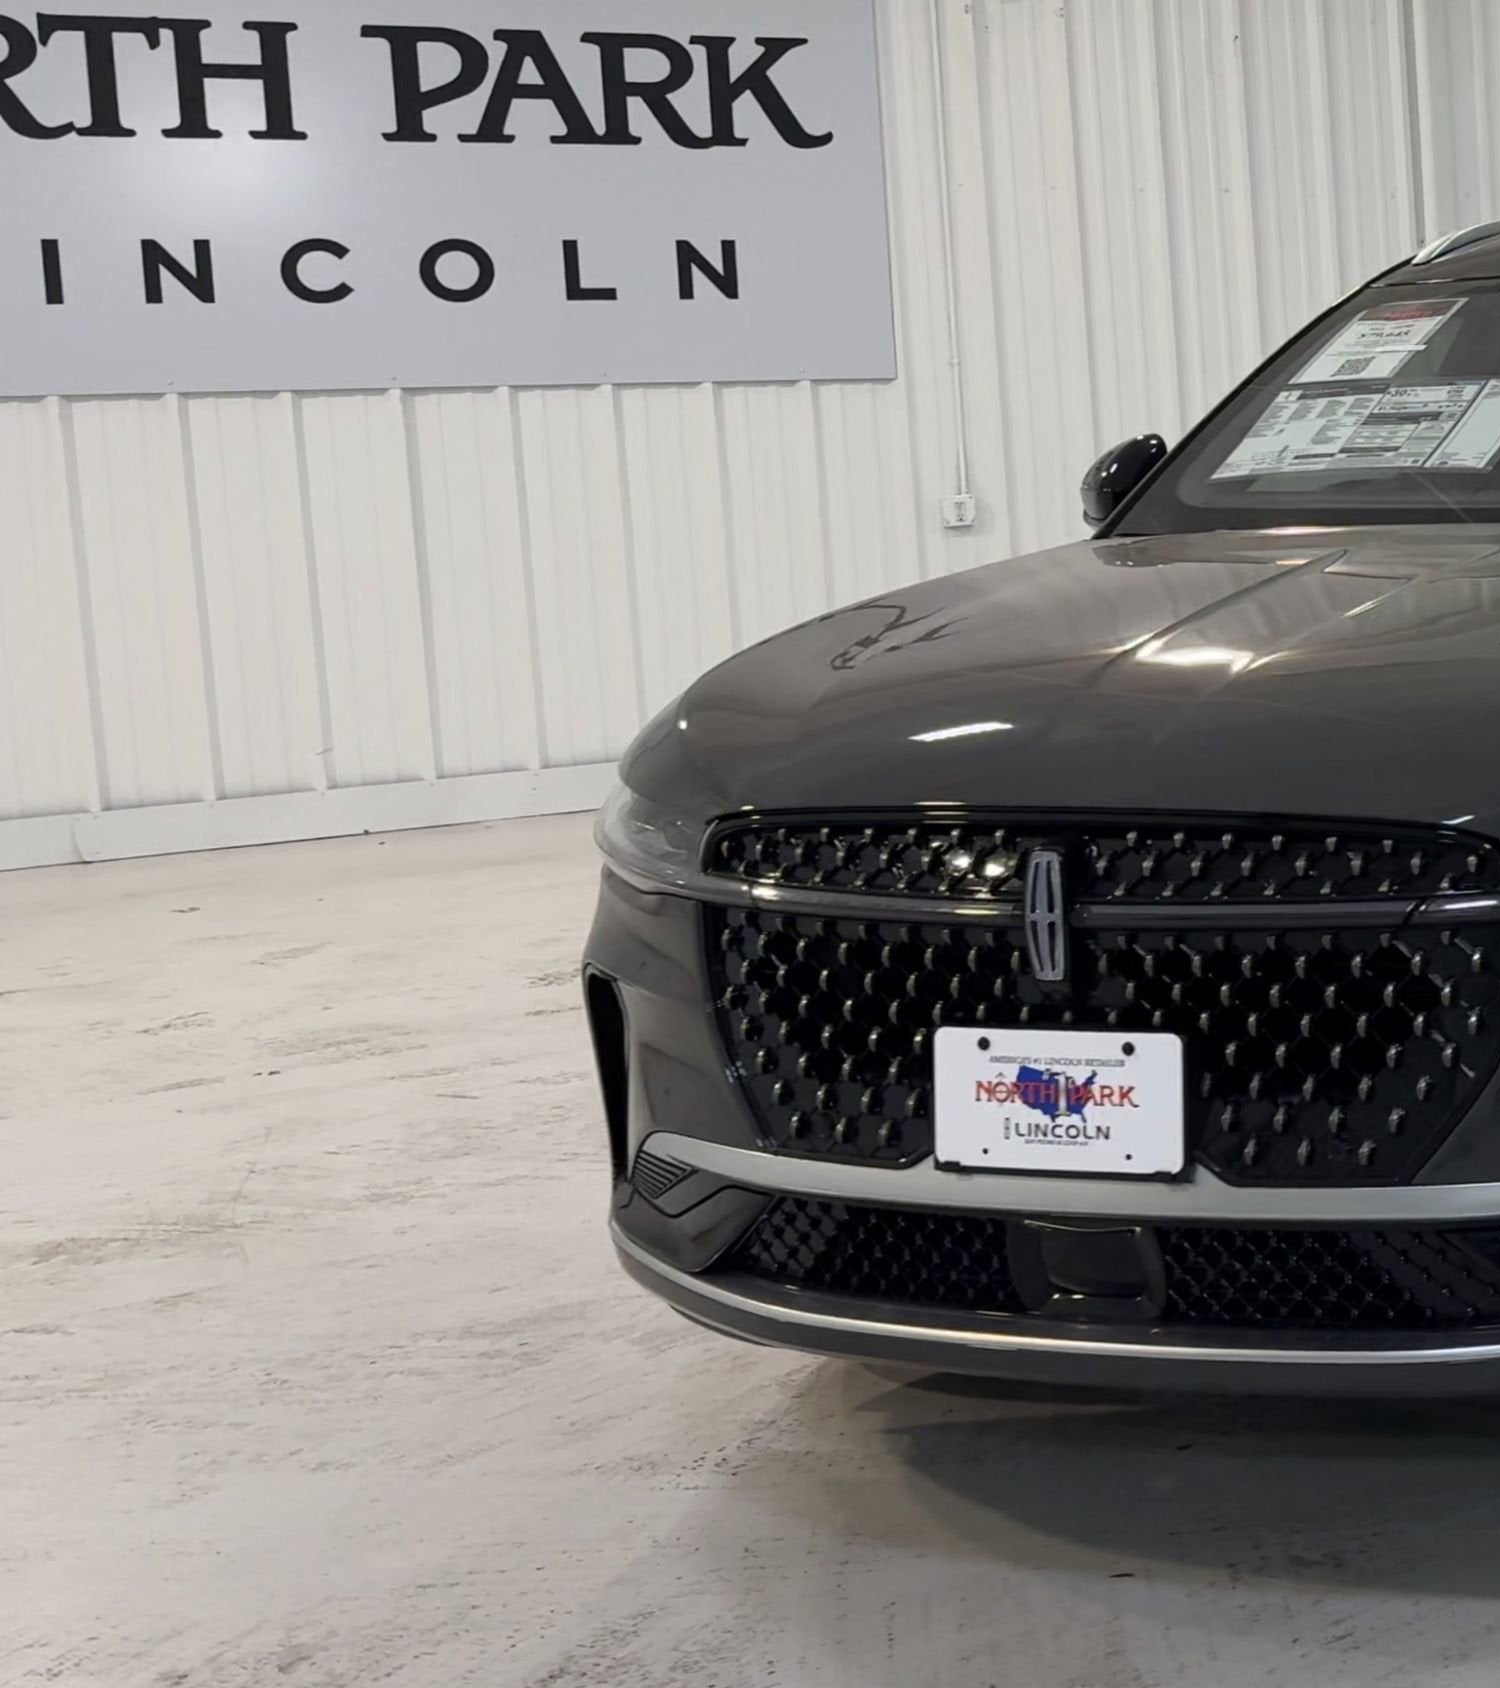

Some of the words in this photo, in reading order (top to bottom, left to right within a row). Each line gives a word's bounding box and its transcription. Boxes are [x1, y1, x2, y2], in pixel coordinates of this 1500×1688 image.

[360, 24, 834, 150] PARK
[1044, 1057, 1082, 1066] LINCOLN
[975, 1080, 1056, 1104] NORTH
[1070, 1084, 1140, 1108] PARK
[1014, 1122, 1111, 1140] LINCOLN
